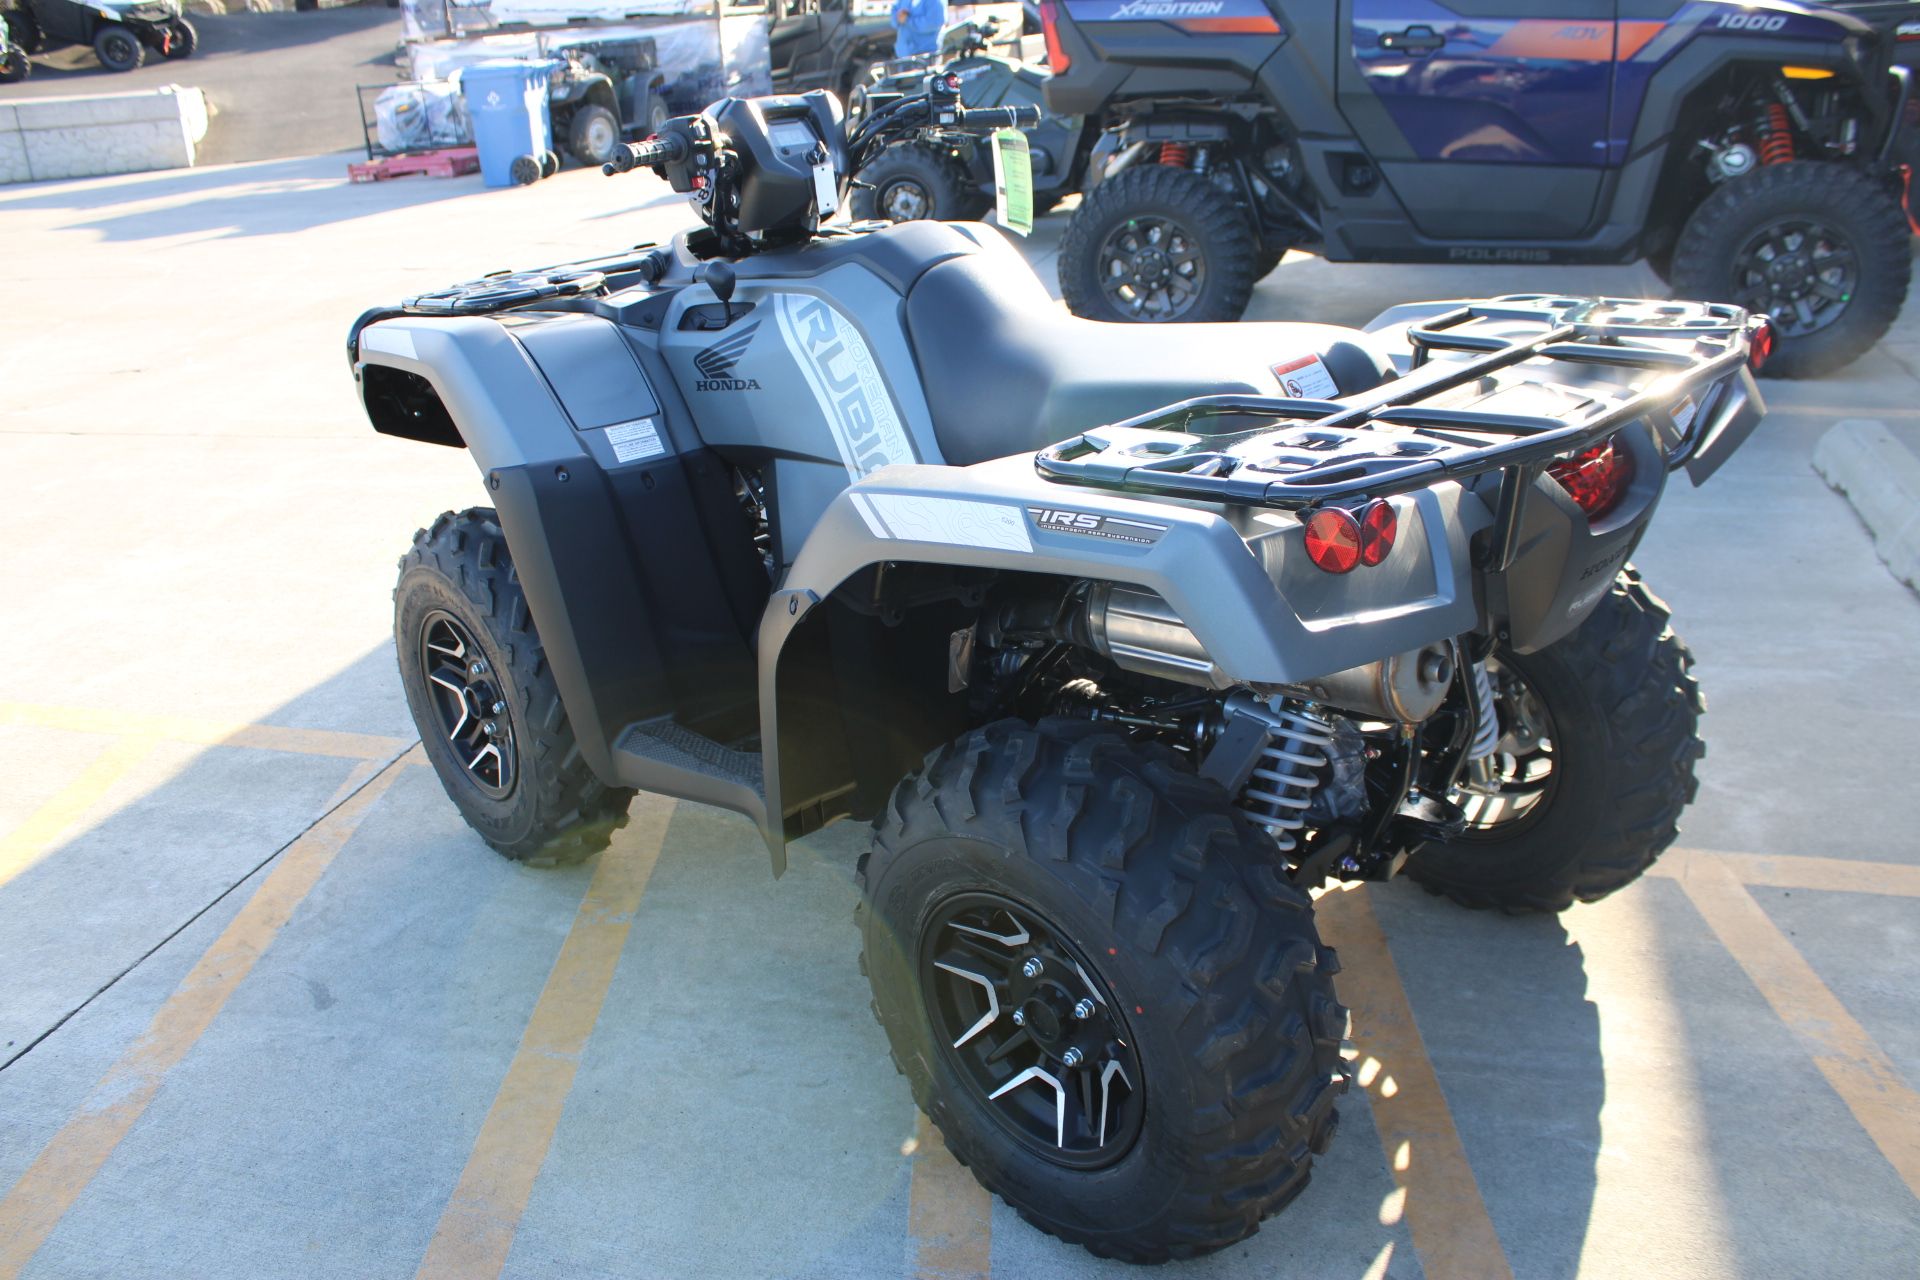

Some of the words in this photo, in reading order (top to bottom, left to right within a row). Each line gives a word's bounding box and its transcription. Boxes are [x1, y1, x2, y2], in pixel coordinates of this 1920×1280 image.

[1110, 0, 1224, 19] XPEDITION
[1717, 12, 1788, 32] 1000
[1552, 26, 1608, 40] ADV
[1448, 247, 1551, 261] POLARIS
[695, 378, 762, 392] HONDA
[840, 322, 904, 461] FOREMAN
[1040, 510, 1101, 529] IRS
